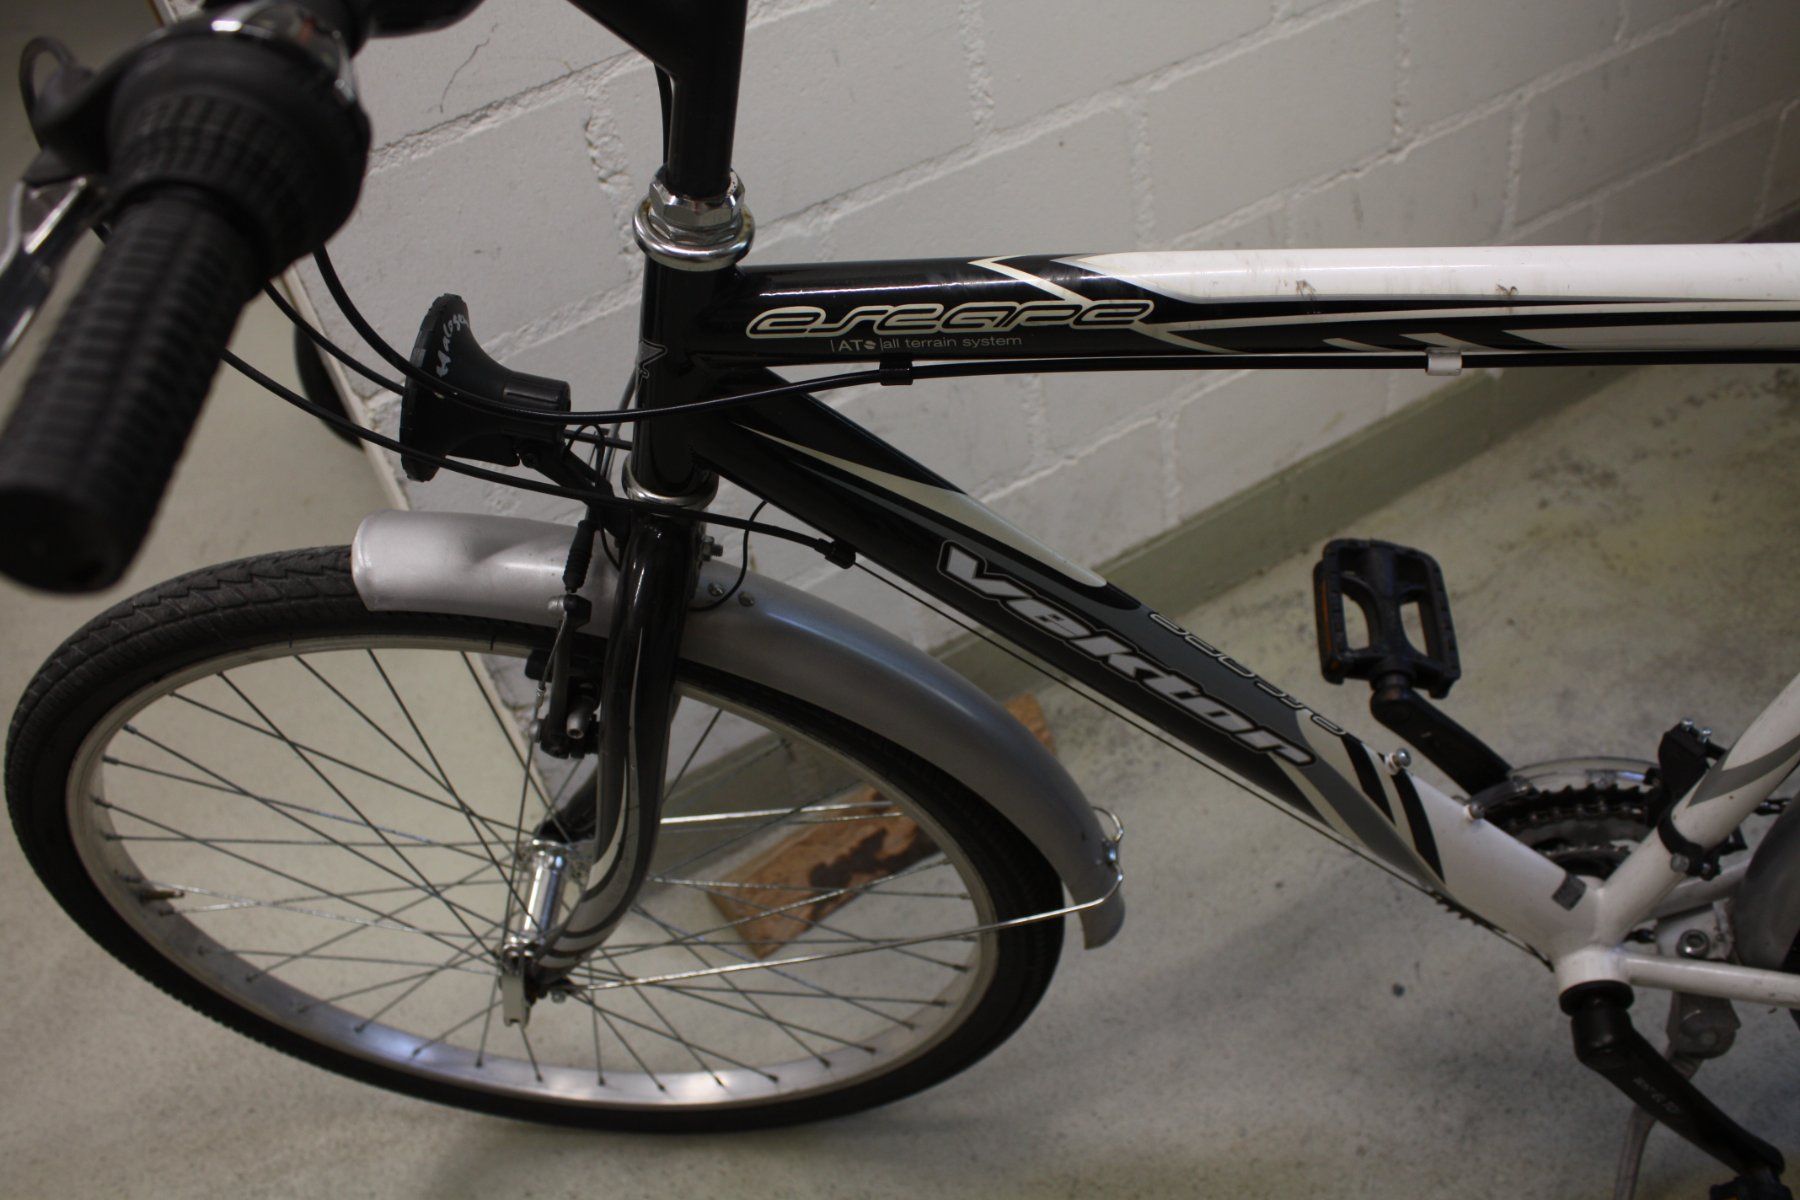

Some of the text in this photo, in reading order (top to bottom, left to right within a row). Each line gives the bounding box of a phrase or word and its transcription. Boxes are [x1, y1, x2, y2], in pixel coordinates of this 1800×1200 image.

[747, 299, 1155, 339] escape
[905, 336, 958, 349] terrain
[962, 336, 1023, 350] system
